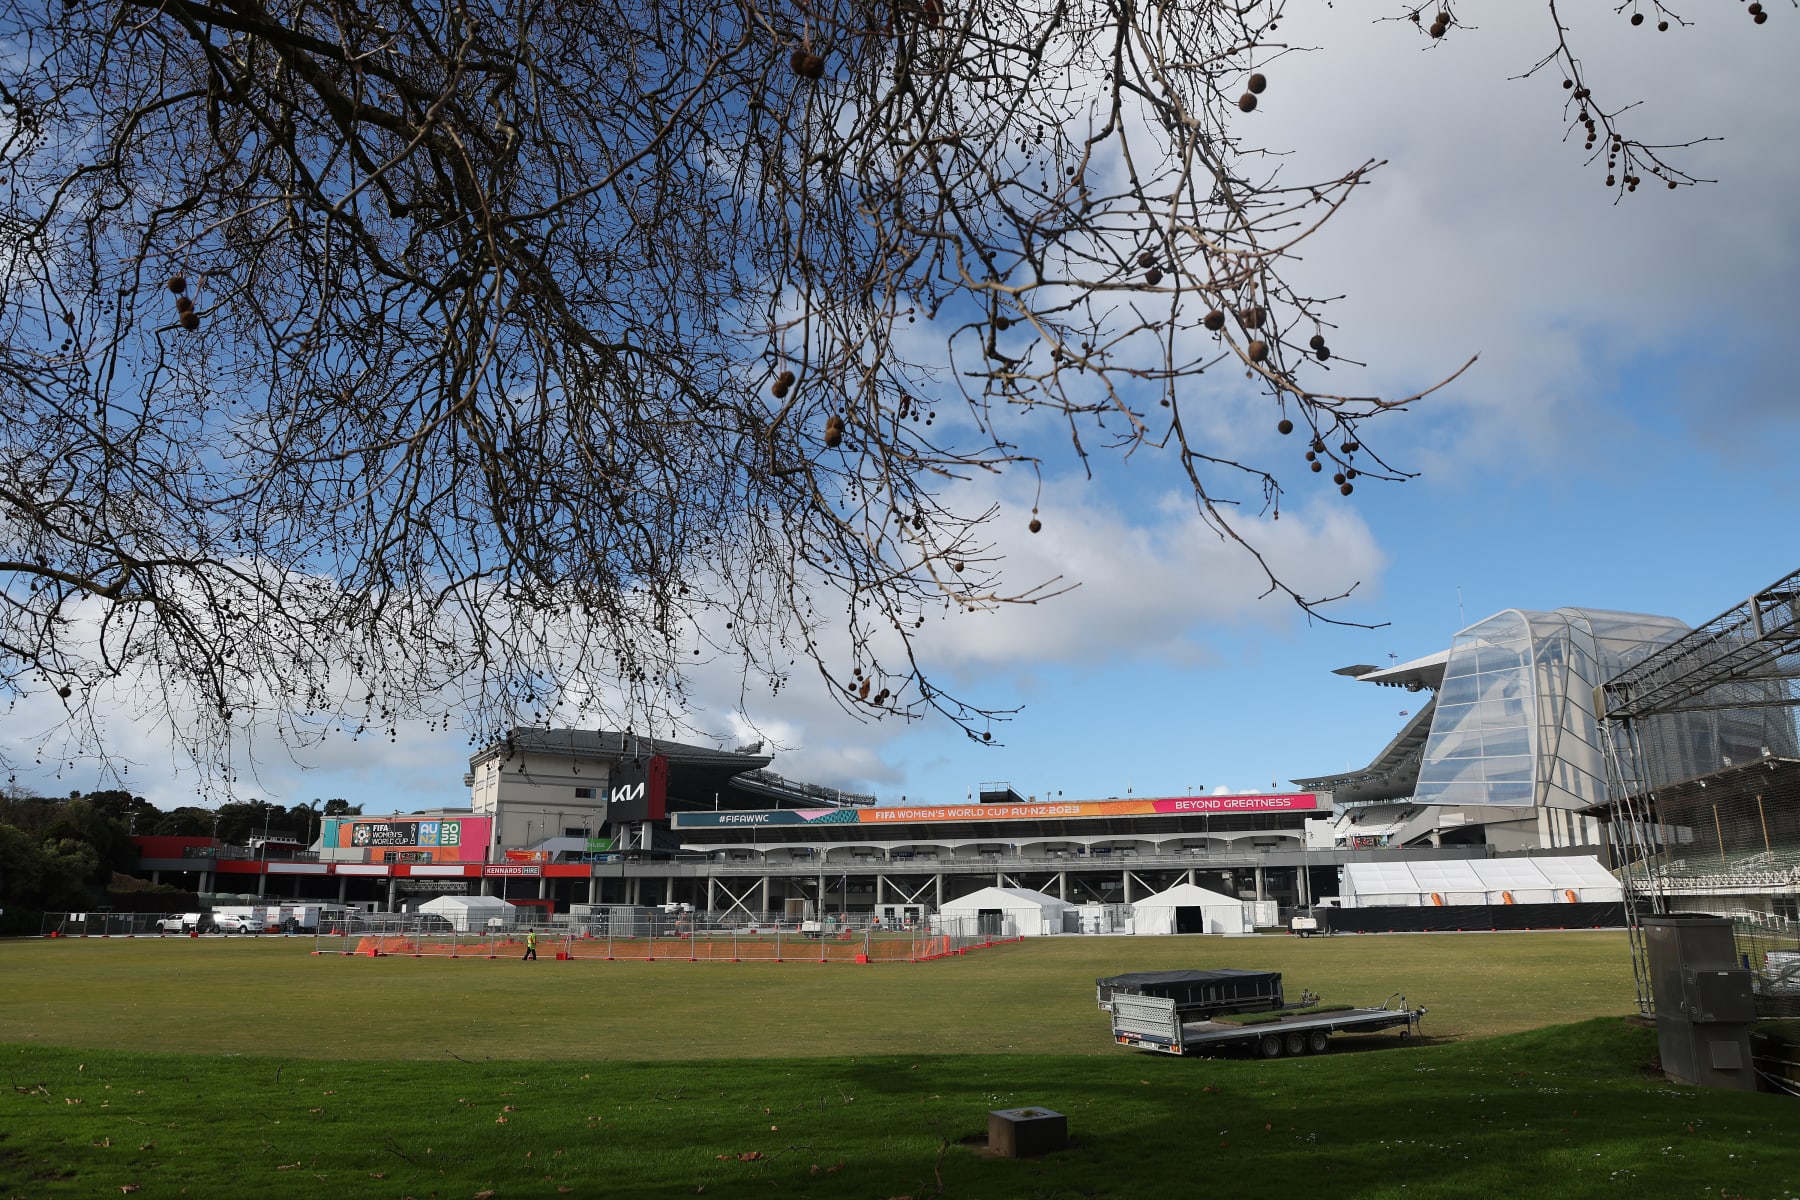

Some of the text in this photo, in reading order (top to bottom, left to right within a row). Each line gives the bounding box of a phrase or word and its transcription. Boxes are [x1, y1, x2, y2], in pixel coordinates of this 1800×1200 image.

[611, 782, 645, 802] KIA
[1175, 800, 1221, 809] BEYOND
[875, 811, 896, 819] FIFA
[897, 809, 945, 818] WOMEN'S
[947, 808, 984, 817] WORLD
[987, 807, 1009, 816] CUP
[719, 814, 769, 823] #FIFAWWC
[420, 824, 438, 834] AU
[441, 824, 459, 834] 20
[420, 835, 437, 844] NZ
[441, 834, 458, 844] 23
